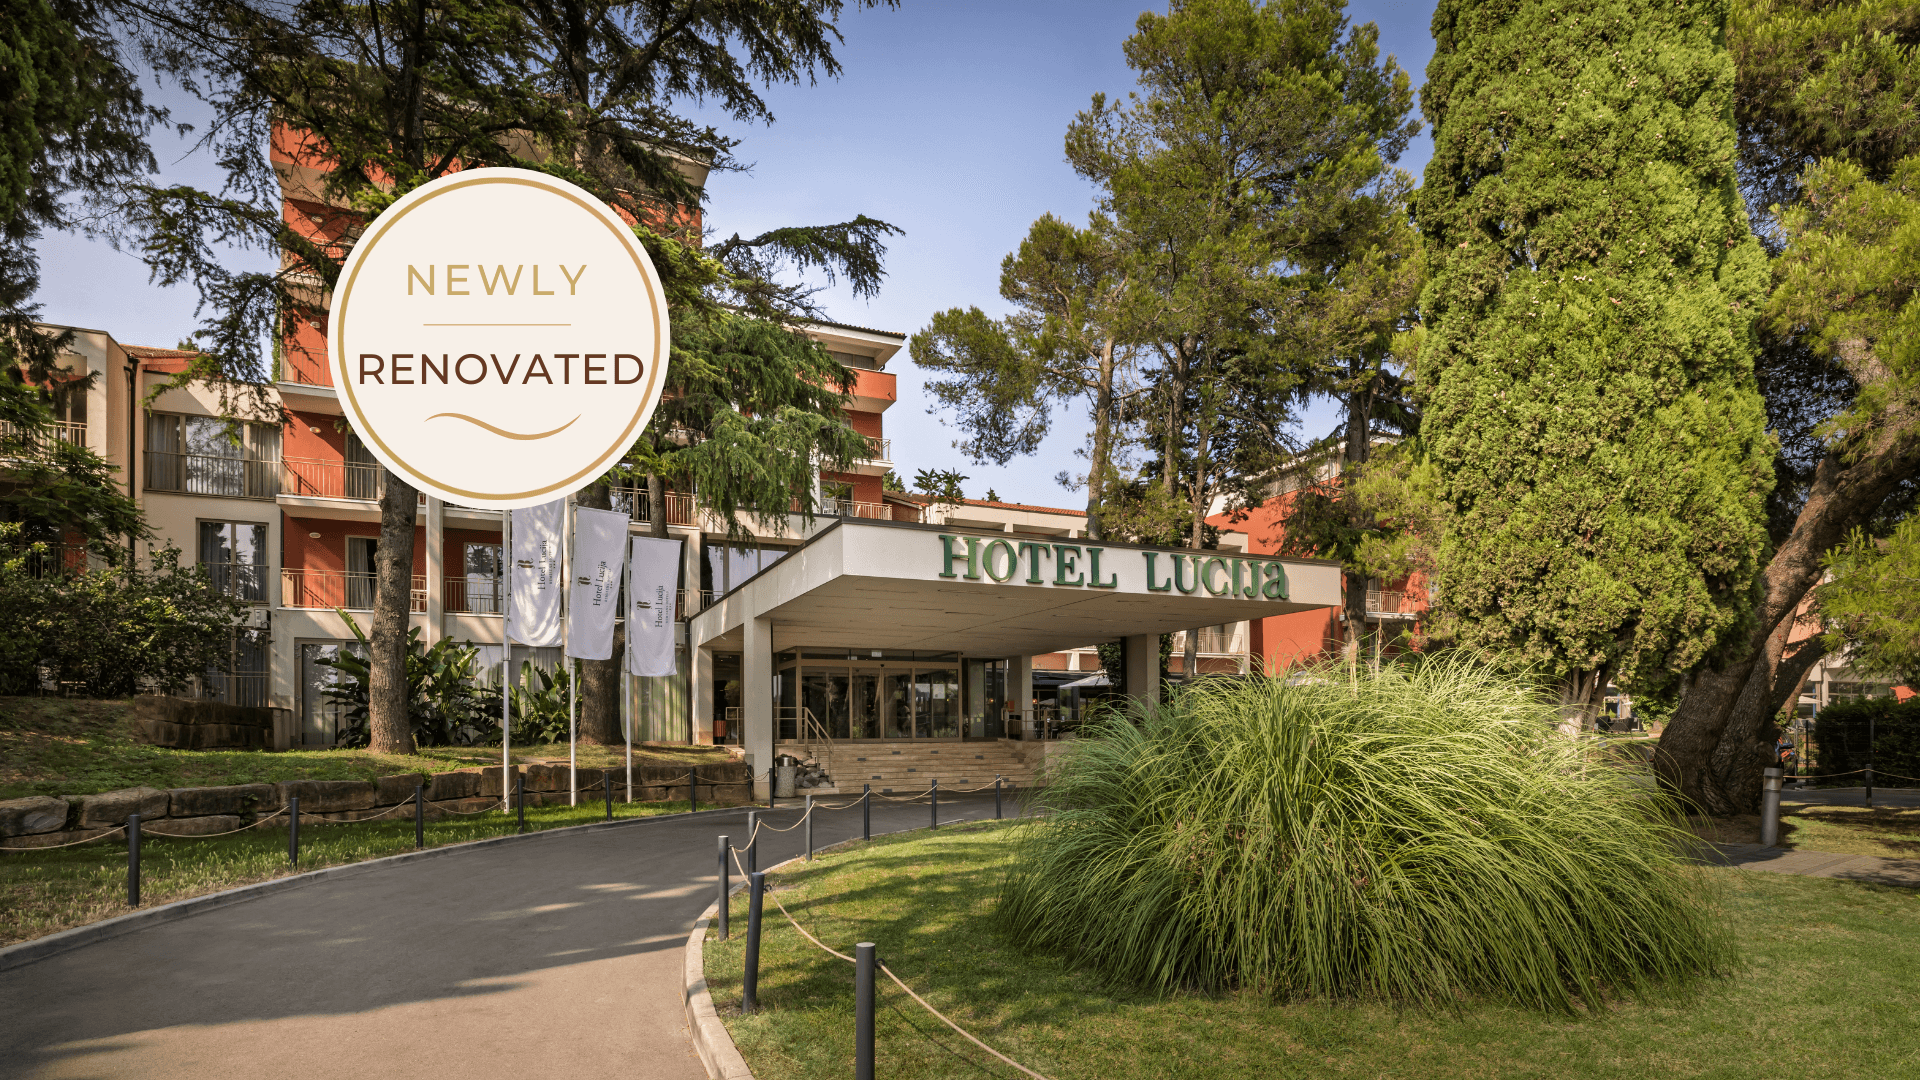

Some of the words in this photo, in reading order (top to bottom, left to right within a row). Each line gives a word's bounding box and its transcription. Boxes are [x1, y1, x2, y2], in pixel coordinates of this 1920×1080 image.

[539, 540, 548, 564] Lucija
[938, 534, 1118, 589] HOTEL
[537, 566, 546, 590] Hotel
[596, 561, 608, 582] Lucija
[593, 584, 603, 606] Hotel
[655, 585, 665, 605] Lucija
